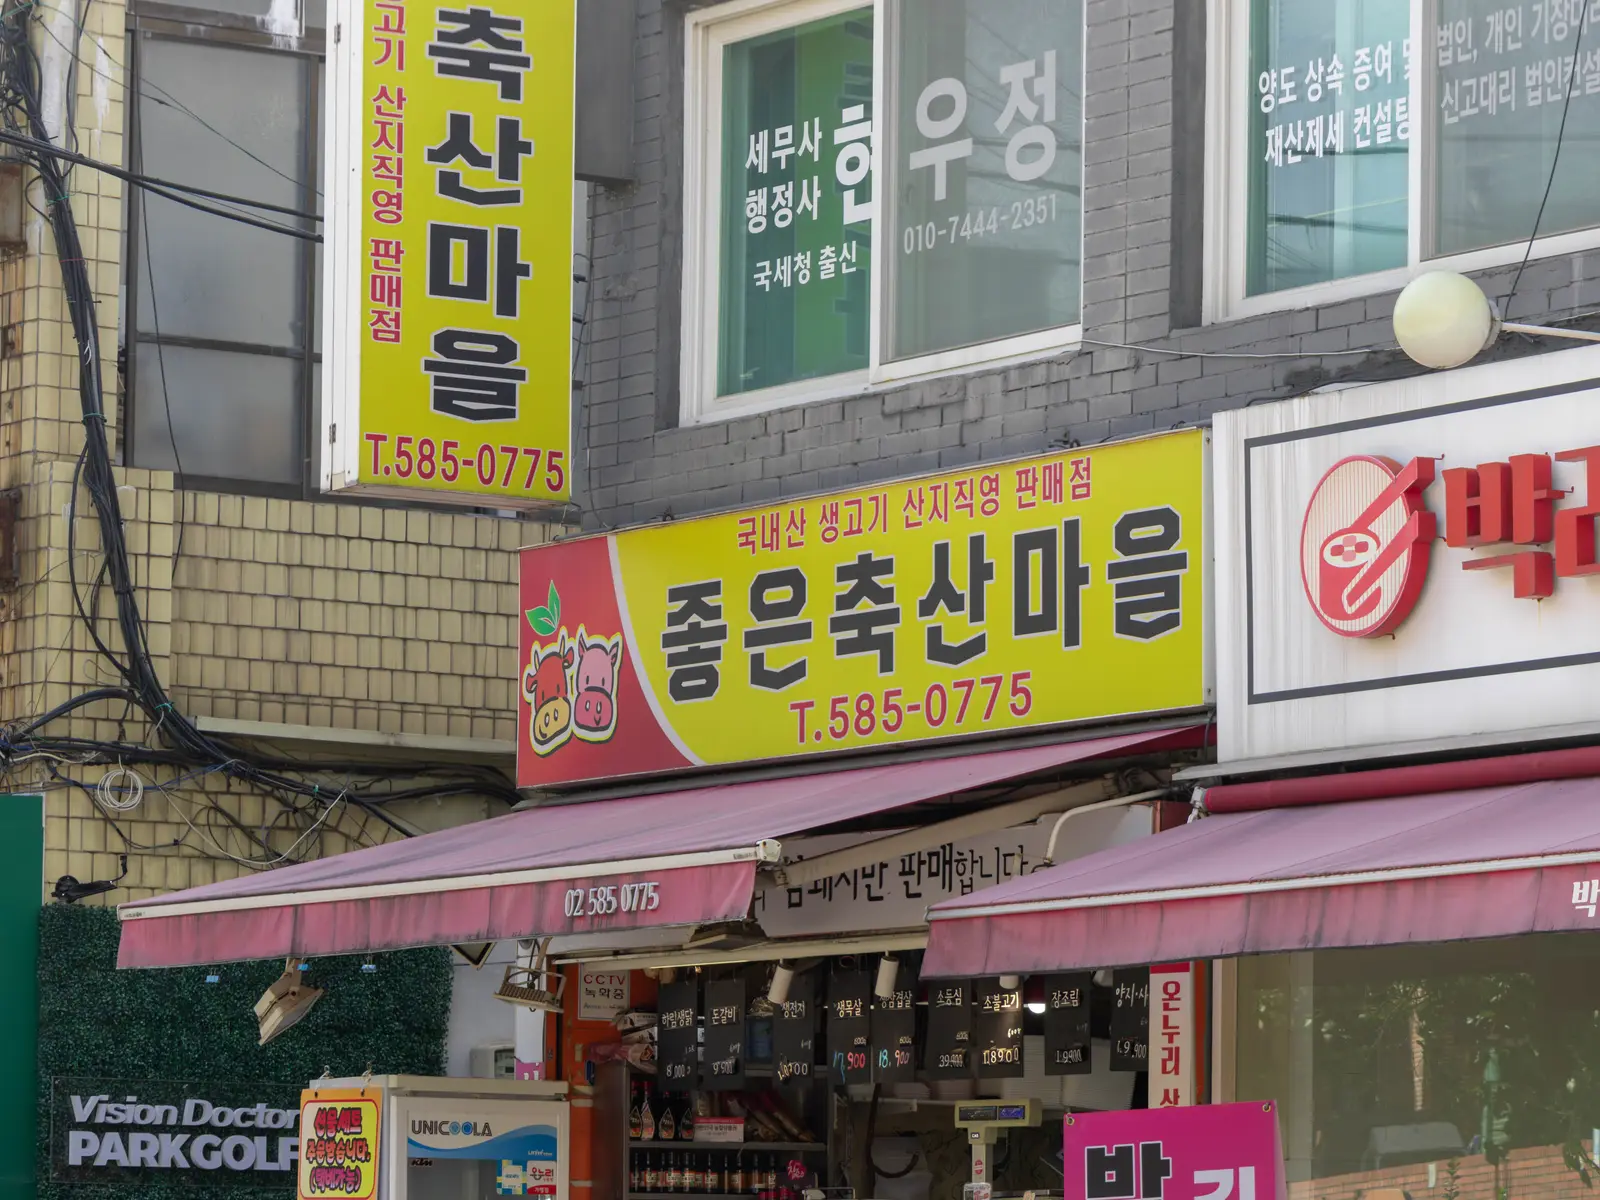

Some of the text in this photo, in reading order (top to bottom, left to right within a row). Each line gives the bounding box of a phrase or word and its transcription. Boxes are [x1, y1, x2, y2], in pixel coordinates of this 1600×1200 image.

[1485, 5, 1523, 55] 개인
[1258, 66, 1297, 114] 양도
[1304, 52, 1345, 102] 상속
[1352, 41, 1392, 92] 증여
[1441, 66, 1516, 126] 신고대리
[371, 85, 407, 225] 산지직영
[744, 116, 823, 175] 세무사
[1264, 110, 1345, 168] 재산제세
[421, 5, 533, 423] 축산마을
[744, 175, 822, 235] 행정사
[903, 193, 1058, 256] 010-7444-2351
[369, 238, 405, 344] 판매점
[753, 240, 858, 293] 국세청 출신
[365, 432, 565, 493] T.585-0775
[737, 456, 1092, 556] 국내산 생고기 산지직영 판매점
[789, 670, 1033, 745] T.585-0775
[564, 881, 660, 917] 02 585 0775
[583, 974, 626, 986] CCTV
[584, 986, 625, 1000] 녹화중
[836, 998, 863, 1017] 생목살
[982, 990, 1020, 1012] 소불고기
[1051, 988, 1079, 1008] 장조림
[711, 1006, 736, 1023] 돈갈비
[1161, 980, 1181, 1076] 온누리
[70, 1094, 301, 1129] Vision Doctor
[411, 1119, 493, 1136] UNICOOLA
